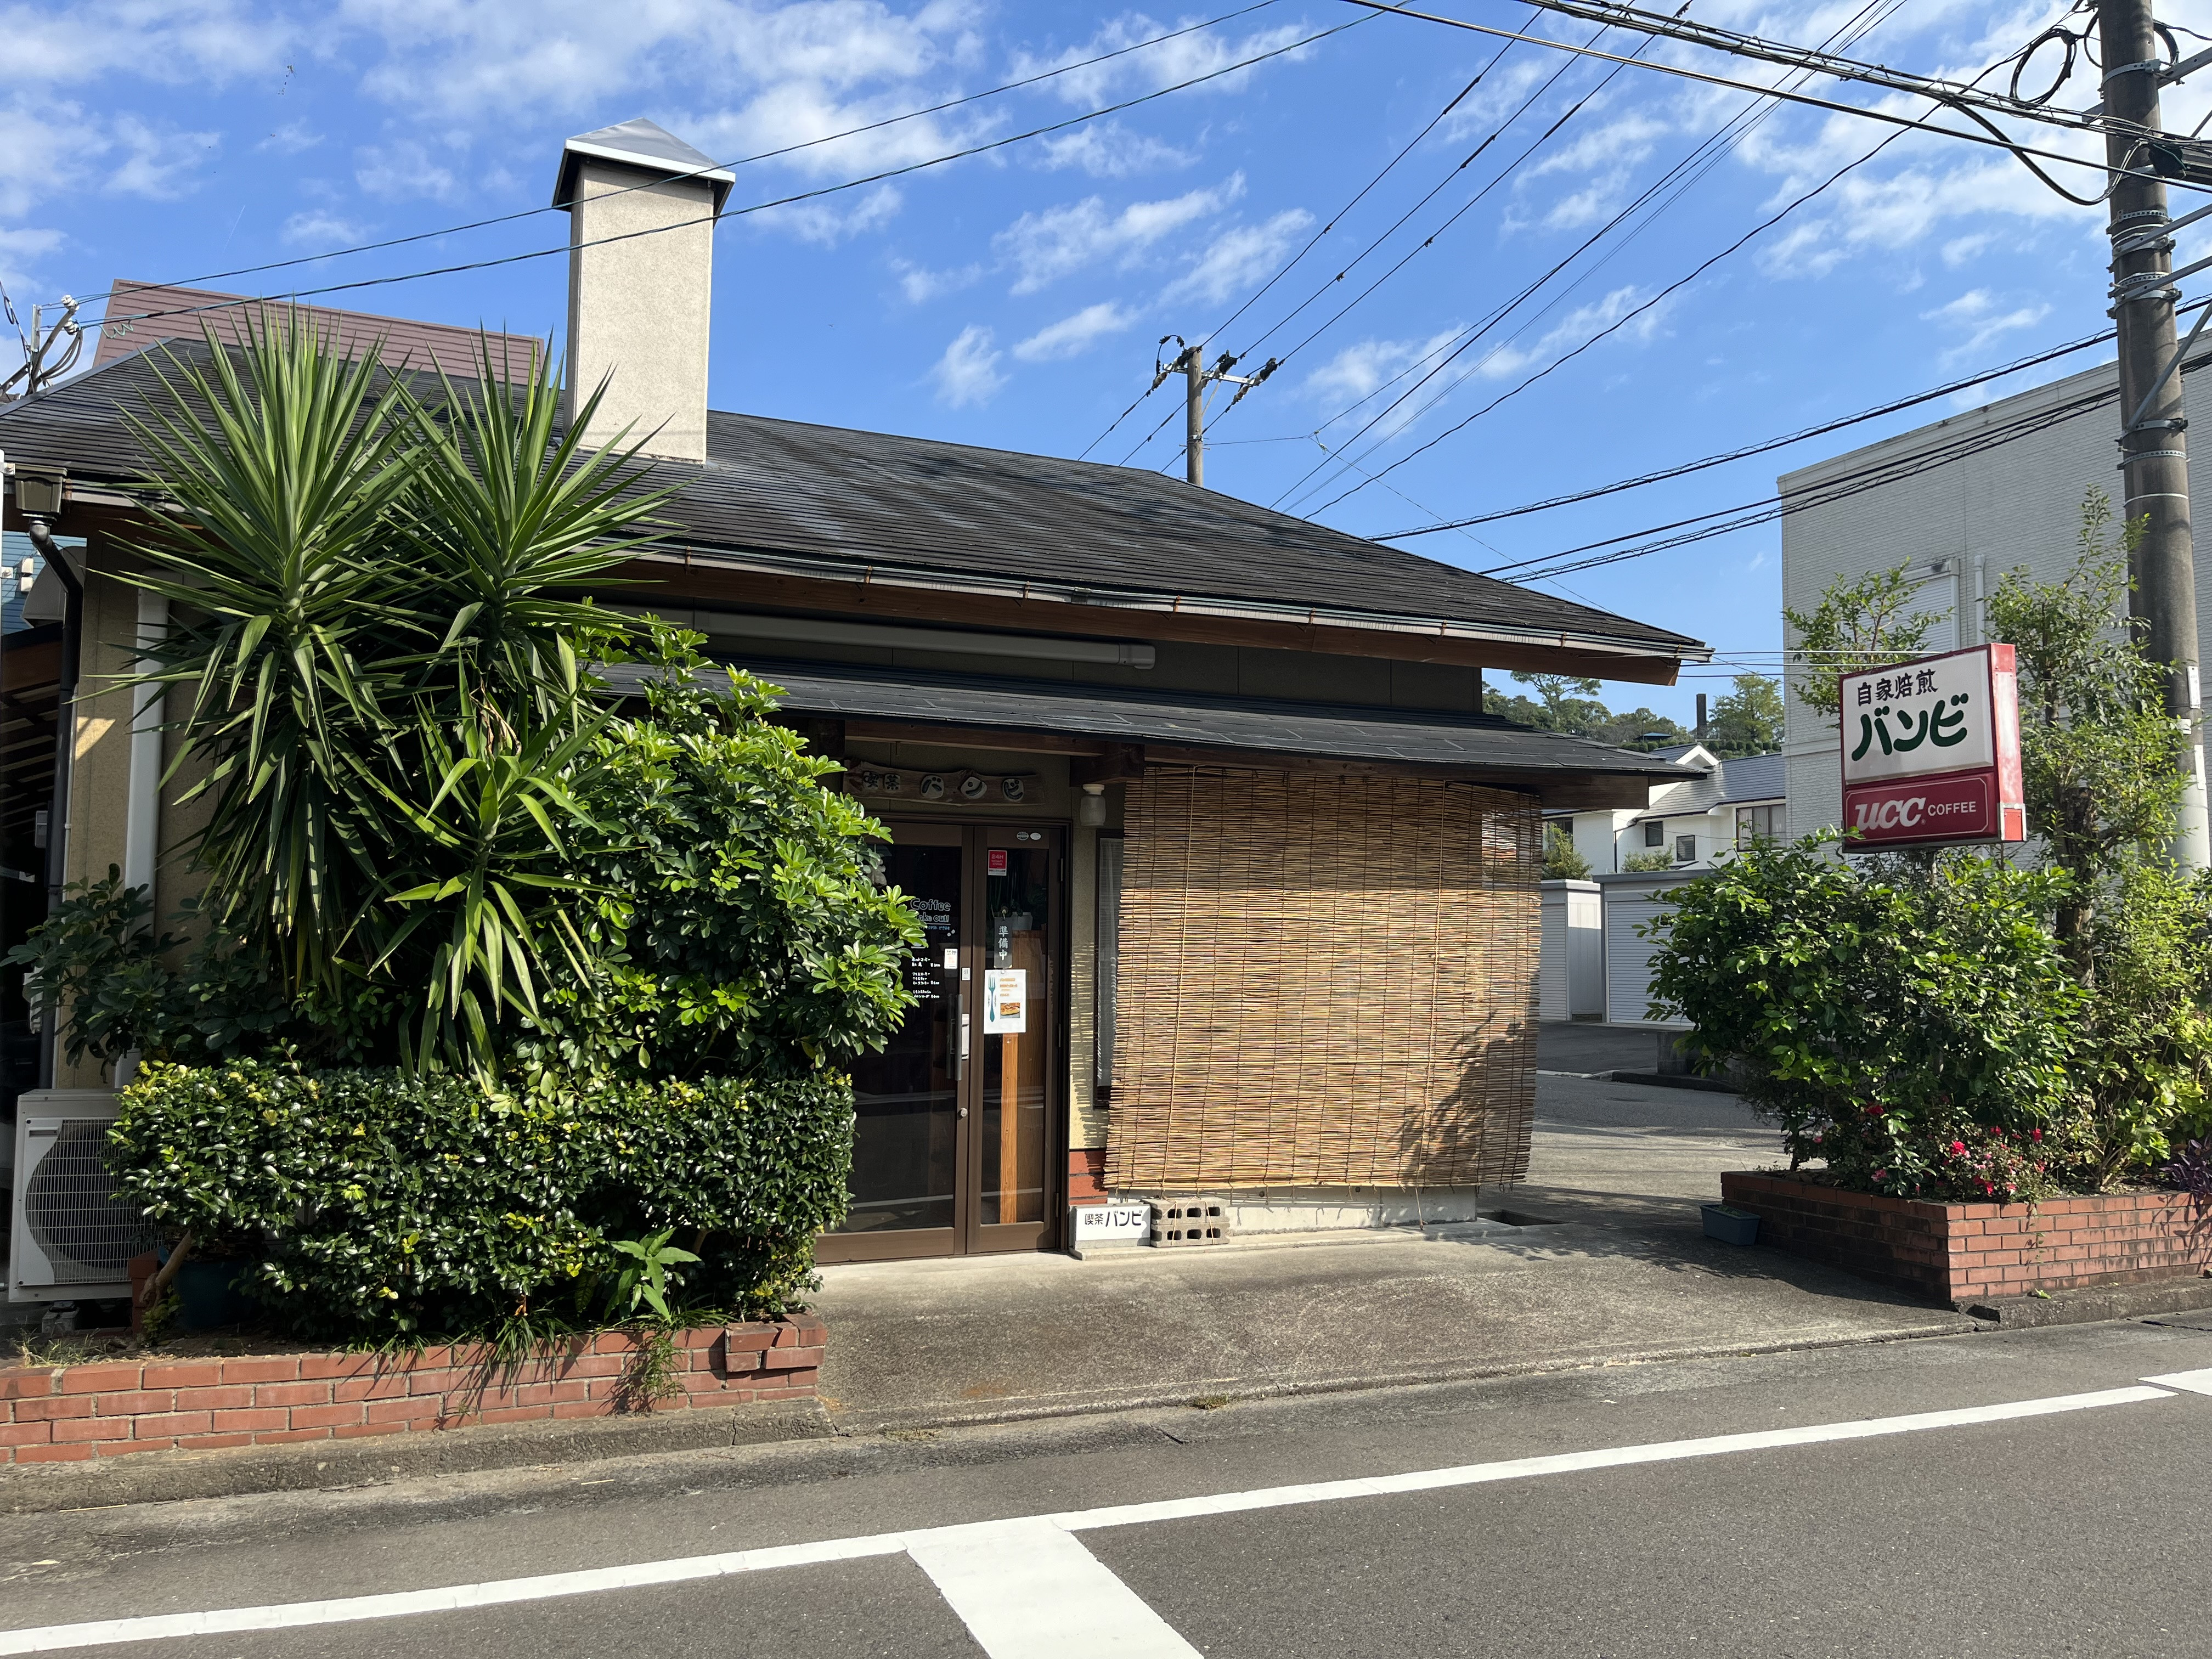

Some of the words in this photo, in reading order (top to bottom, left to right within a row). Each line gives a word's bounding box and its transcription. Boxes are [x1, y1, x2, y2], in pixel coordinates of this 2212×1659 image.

[1857, 668, 1938, 707] 自家焙煎
[1851, 693, 1969, 761] バンビ
[863, 771, 900, 790] 喫茶
[921, 776, 1023, 800] バンビ
[1855, 797, 1926, 831] UCC
[1927, 801, 1977, 816] COFFEE
[910, 898, 951, 911] Coffee
[918, 912, 932, 922] ake
[997, 926, 1009, 961] 準備中
[1084, 1213, 1104, 1226] 喫茶
[1105, 1210, 1143, 1227] バンビ
